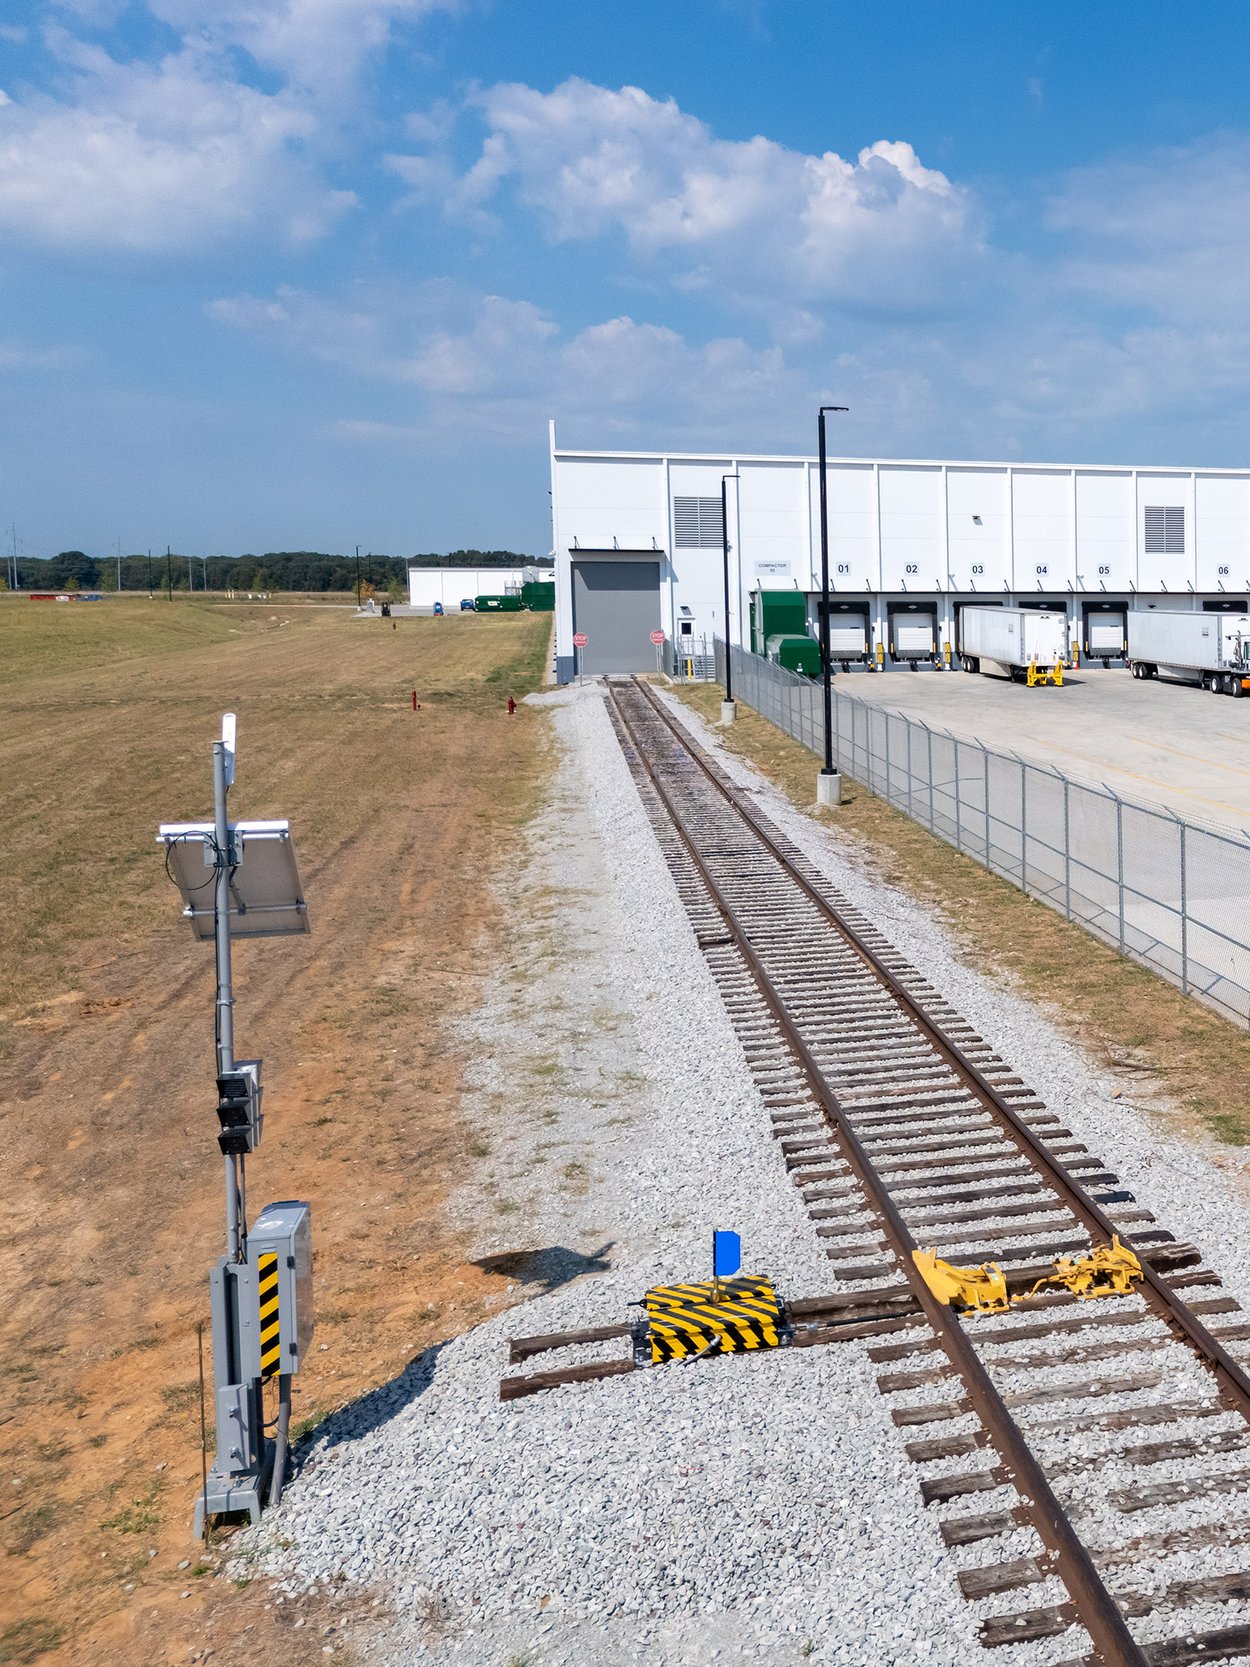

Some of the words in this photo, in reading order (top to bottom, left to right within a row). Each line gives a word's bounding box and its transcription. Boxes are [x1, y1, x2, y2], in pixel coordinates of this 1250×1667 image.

[838, 564, 849, 573] 01
[906, 564, 918, 573] 02
[972, 565, 984, 574] 03
[1036, 566, 1048, 575] 04
[1098, 566, 1110, 575] 05
[1218, 567, 1229, 575] 06
